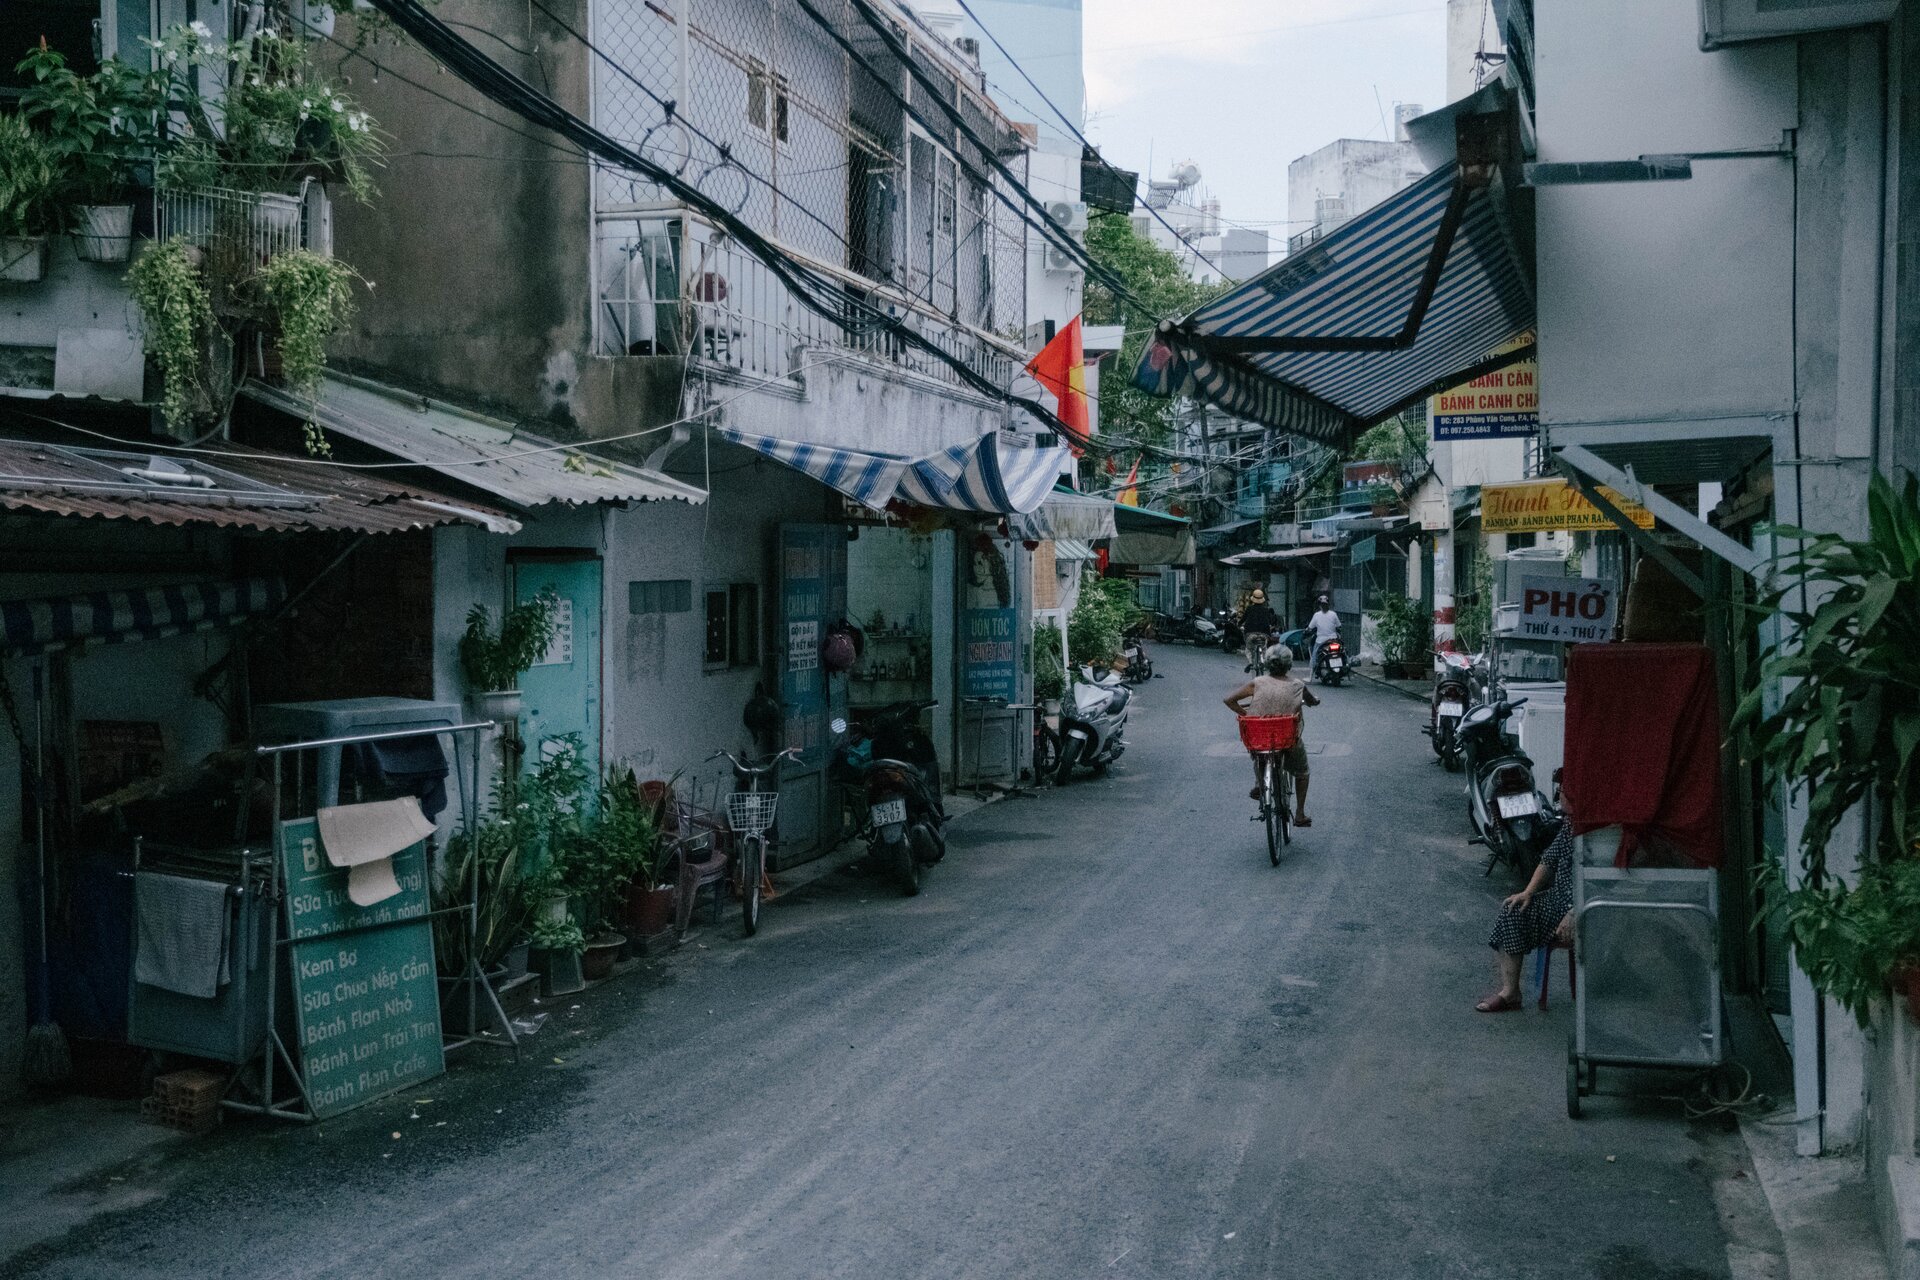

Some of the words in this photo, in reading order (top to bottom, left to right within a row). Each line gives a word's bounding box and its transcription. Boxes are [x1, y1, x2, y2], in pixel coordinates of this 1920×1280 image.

[1507, 369, 1533, 387] CĂN
[1440, 393, 1475, 411] BÁNH
[1478, 394, 1513, 409] CANH
[1488, 487, 1550, 515] Thanh
[1566, 514, 1589, 524] PHAN
[1524, 582, 1610, 620] PHỞ
[1525, 621, 1549, 635] THỨ
[1552, 625, 1559, 636] 4
[1571, 624, 1596, 639] THỨ
[1599, 628, 1607, 640] 7
[294, 894, 322, 916] Sữa
[300, 957, 335, 980] Kem
[338, 949, 358, 970] Bơ
[303, 990, 331, 1012] Sữa
[335, 980, 368, 1002] Chua
[371, 966, 398, 991] Nếp
[401, 955, 430, 982] Cẩm
[307, 1014, 347, 1045] Bánh
[351, 1008, 380, 1030] Flan
[384, 991, 414, 1019] Nhỏ
[310, 1046, 349, 1077] Bánh
[382, 1027, 409, 1050] Trái
[411, 1020, 436, 1040] Tim
[313, 1078, 354, 1109] Bánh
